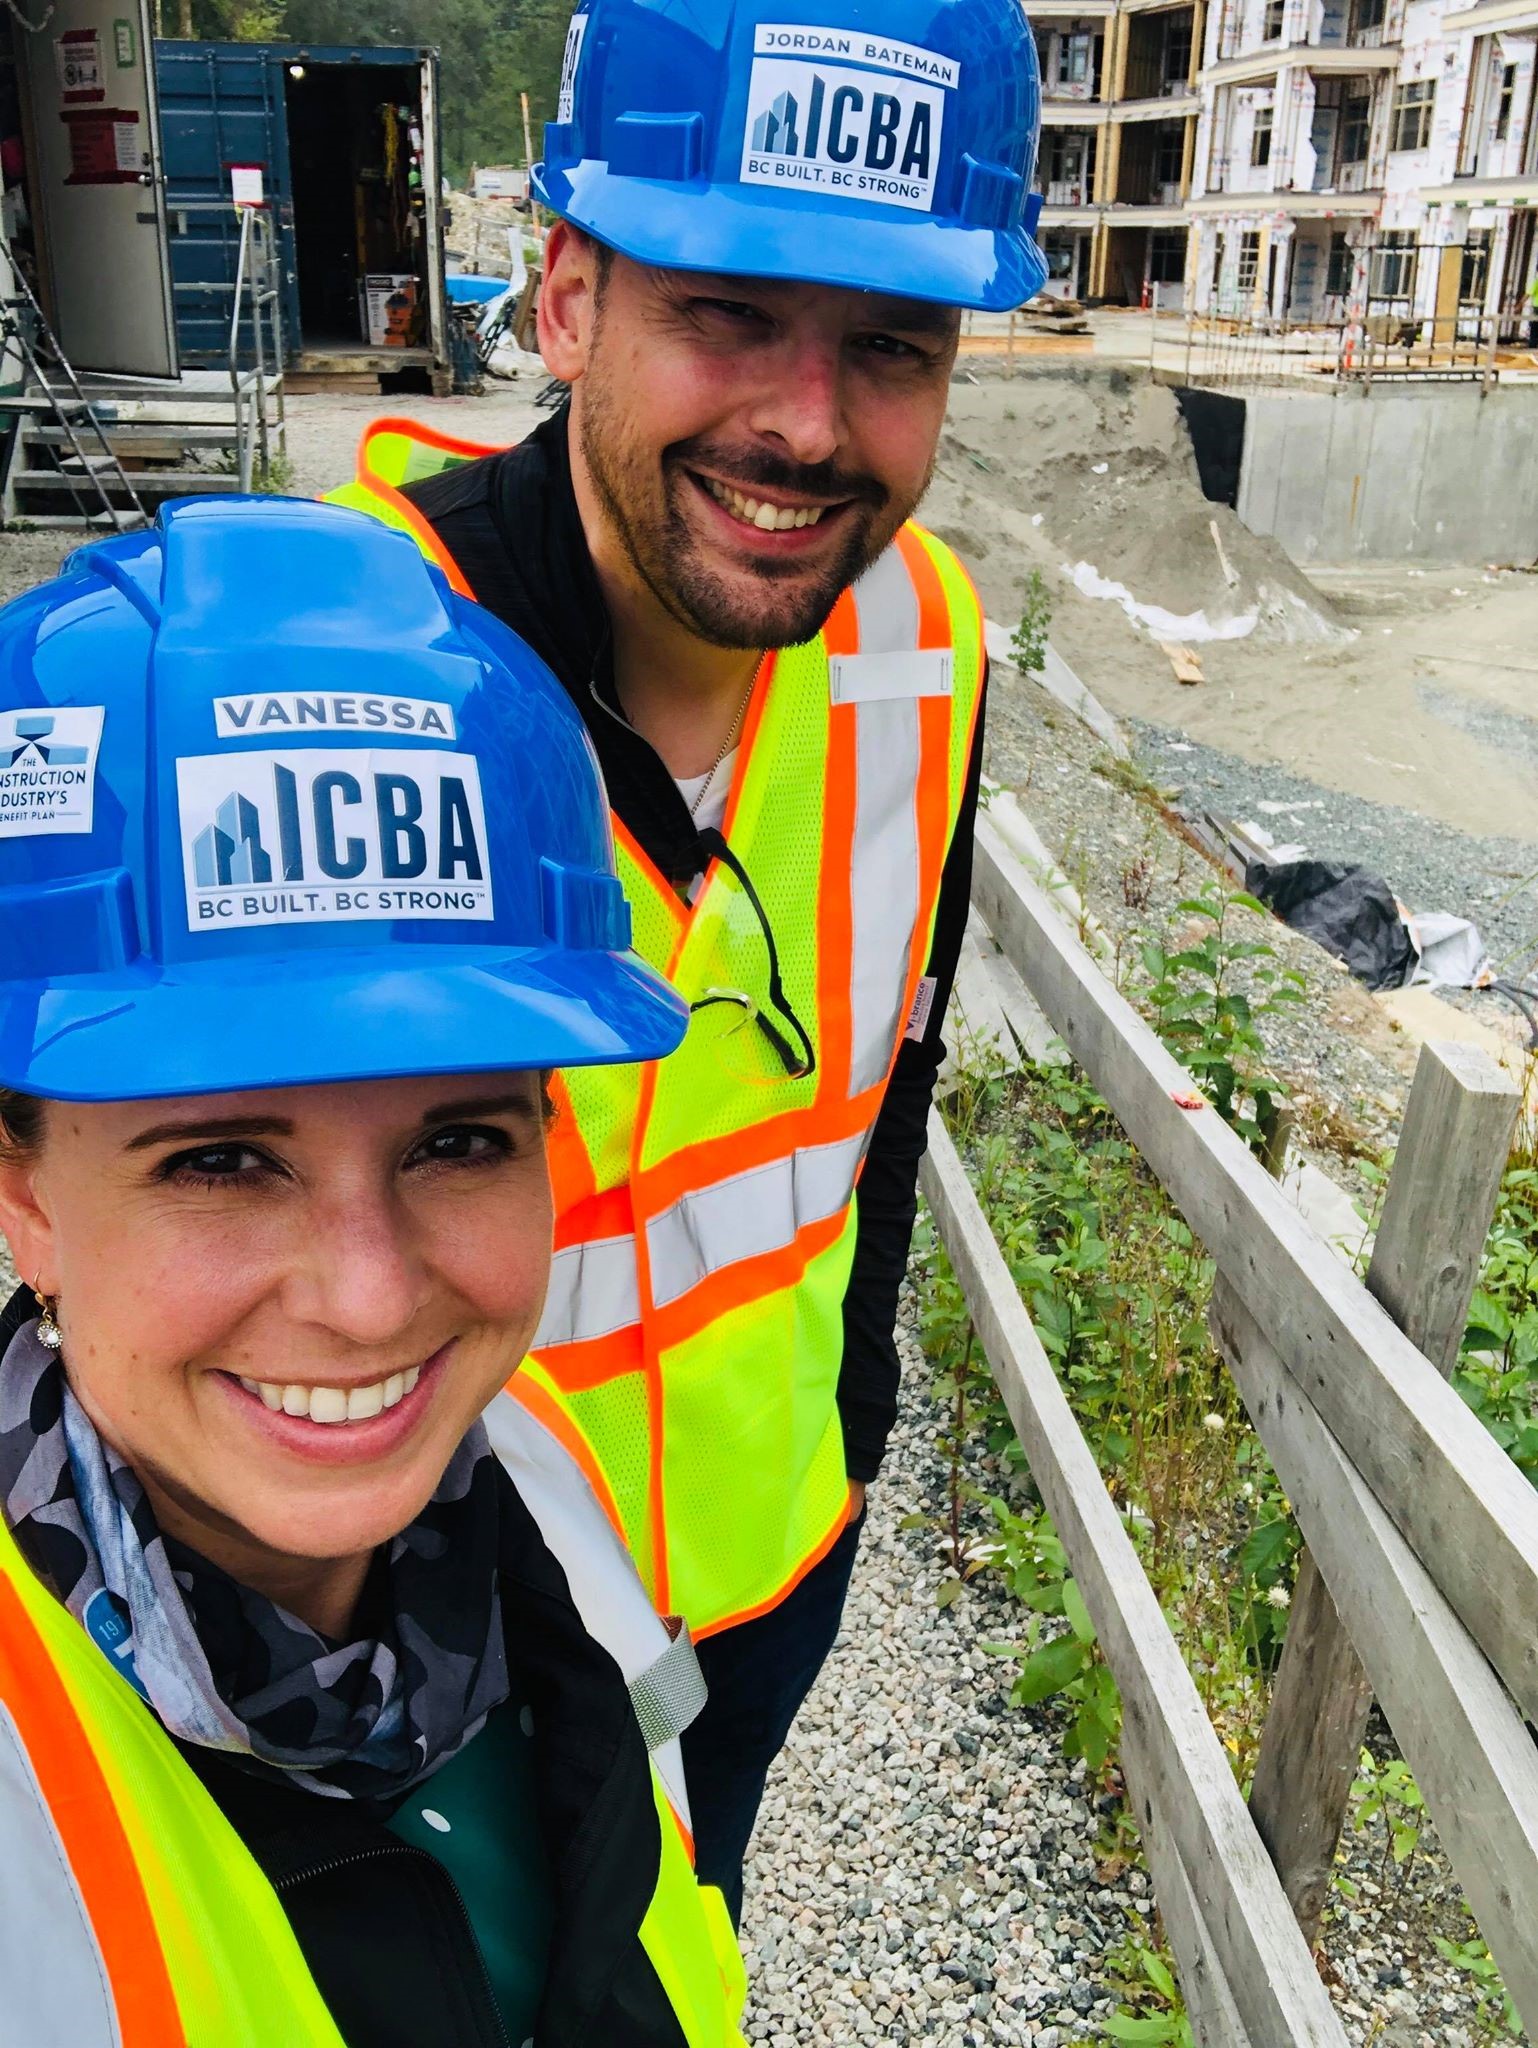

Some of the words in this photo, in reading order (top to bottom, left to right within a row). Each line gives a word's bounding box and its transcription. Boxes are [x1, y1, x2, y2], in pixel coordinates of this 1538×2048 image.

[765, 32, 851, 54] JORDAN
[864, 43, 952, 82] BATEMAN
[803, 72, 931, 180] ICBA
[748, 159, 771, 174] BC
[775, 163, 826, 183] BUILT.
[831, 171, 854, 187] BC
[222, 696, 448, 735] VANESSA
[22, 758, 37, 767] THE
[0, 769, 86, 788] STRUCTION
[31, 810, 55, 821] PLAN
[272, 761, 484, 881] ICBA
[198, 898, 234, 920] BC
[243, 893, 327, 917] BUILT.
[335, 892, 370, 911] BC
